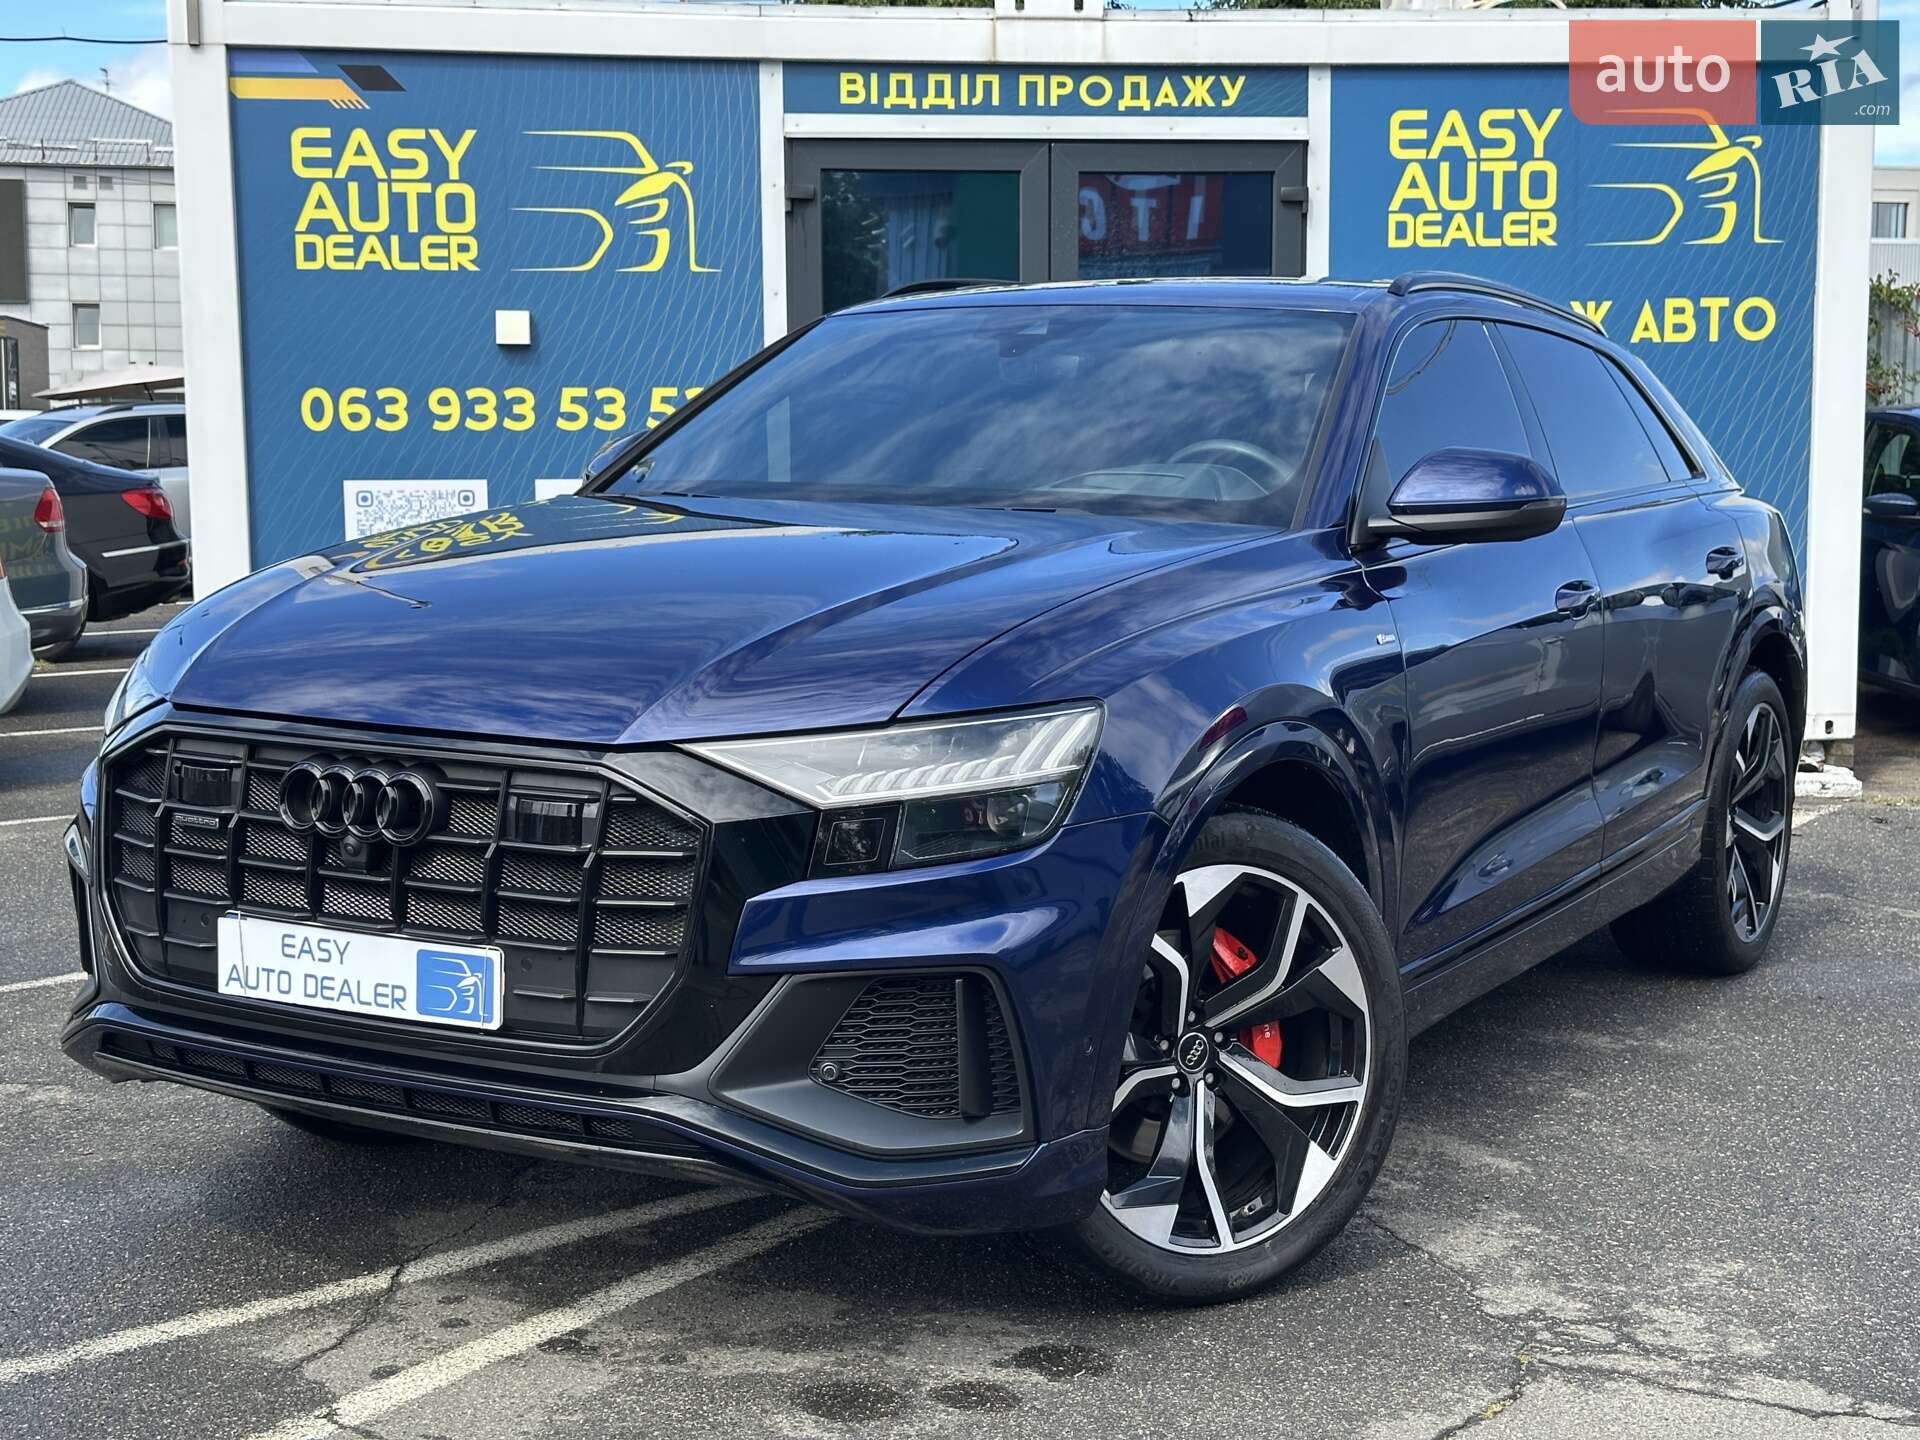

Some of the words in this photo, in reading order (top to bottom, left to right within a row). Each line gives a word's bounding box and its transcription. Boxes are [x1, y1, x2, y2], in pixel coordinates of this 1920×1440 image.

[839, 71, 1001, 109] ВІДДІЛ
[1018, 74, 1246, 111] ПРОДАЖУ
[290, 127, 477, 180] EASY
[1388, 108, 1562, 160] EASY
[295, 181, 477, 234] AUTO
[1388, 159, 1558, 212] AUTO
[294, 234, 481, 272] DEALER
[1387, 210, 1558, 249] DEALER
[1629, 296, 1777, 343] АВТО
[300, 386, 409, 432] 063
[427, 386, 536, 432] 933
[556, 386, 627, 432] 53
[645, 386, 705, 431] 5
[280, 932, 351, 965] EASY
[224, 963, 293, 995] AUTO
[302, 972, 408, 1011] DEALER
